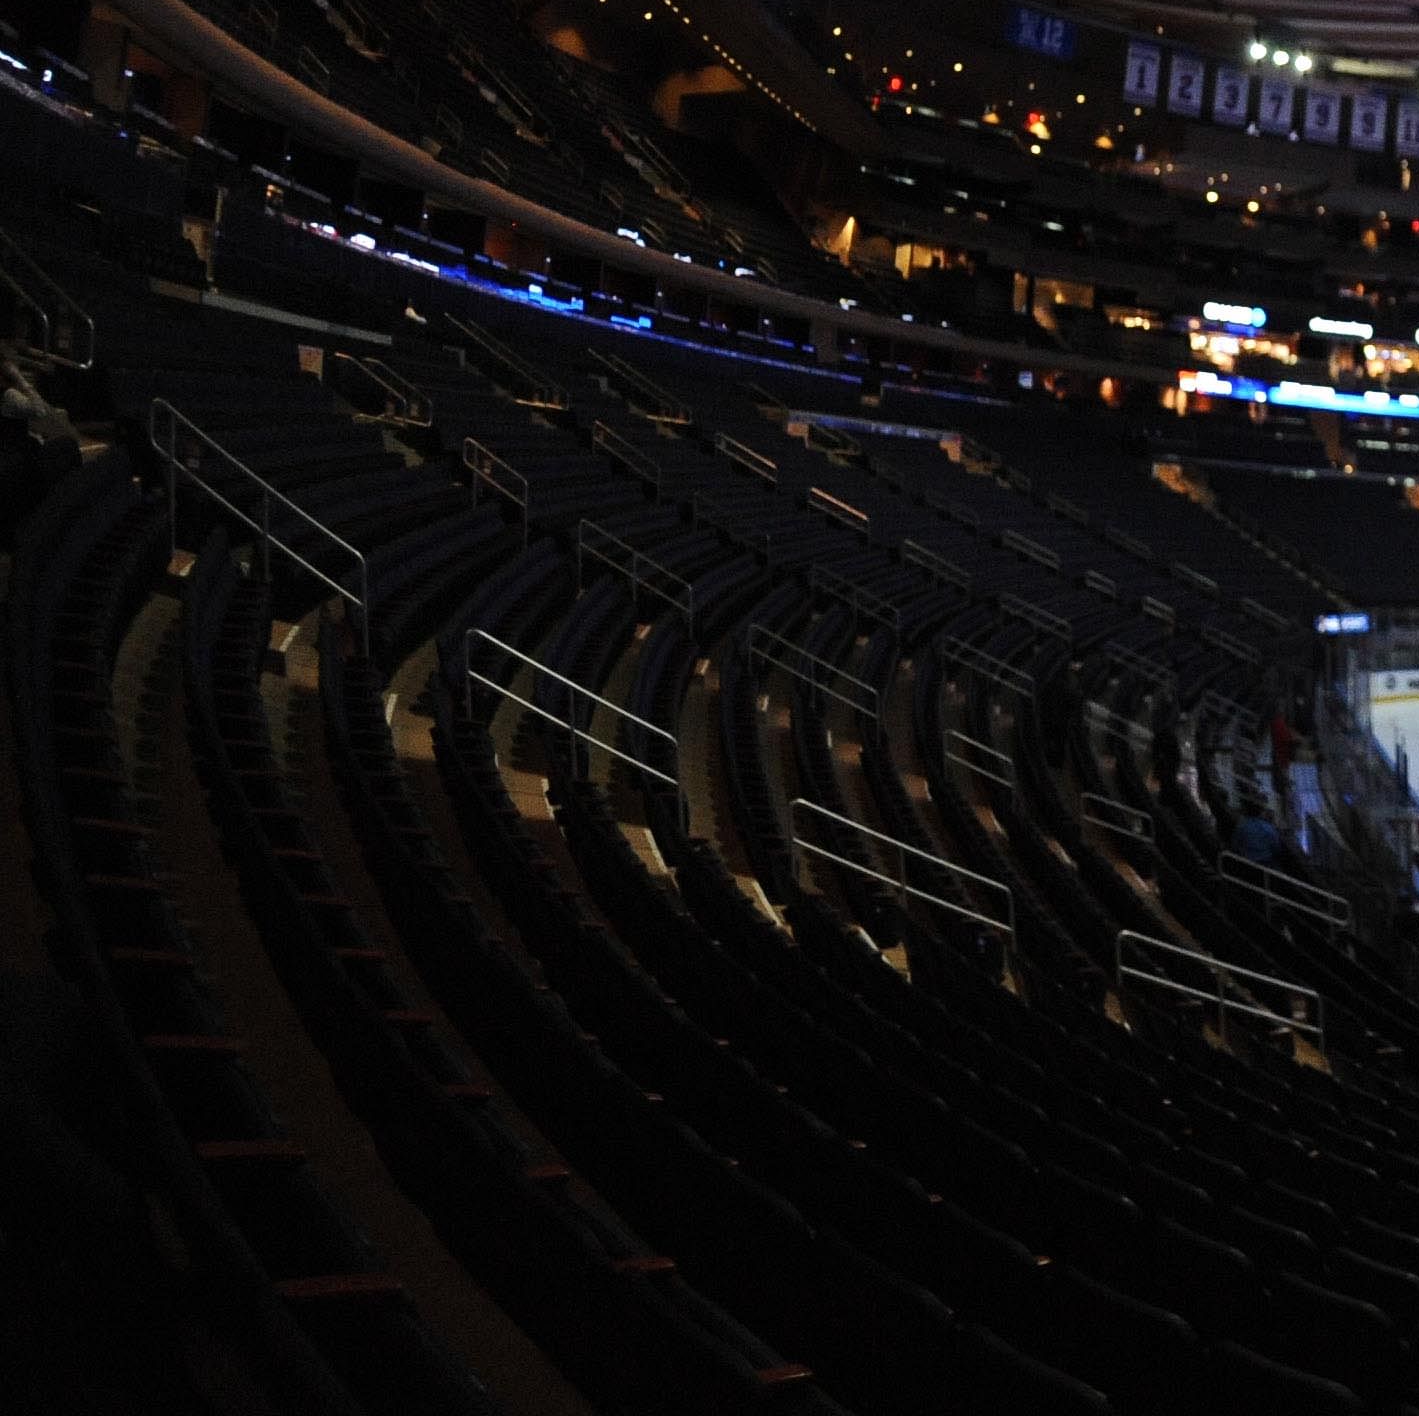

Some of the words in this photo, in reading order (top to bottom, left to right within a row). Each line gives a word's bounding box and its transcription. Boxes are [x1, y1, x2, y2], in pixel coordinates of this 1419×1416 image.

[1136, 63, 1146, 90] 1
[1178, 74, 1194, 100] 2
[1223, 84, 1239, 111] 3
[1269, 93, 1284, 122] 7
